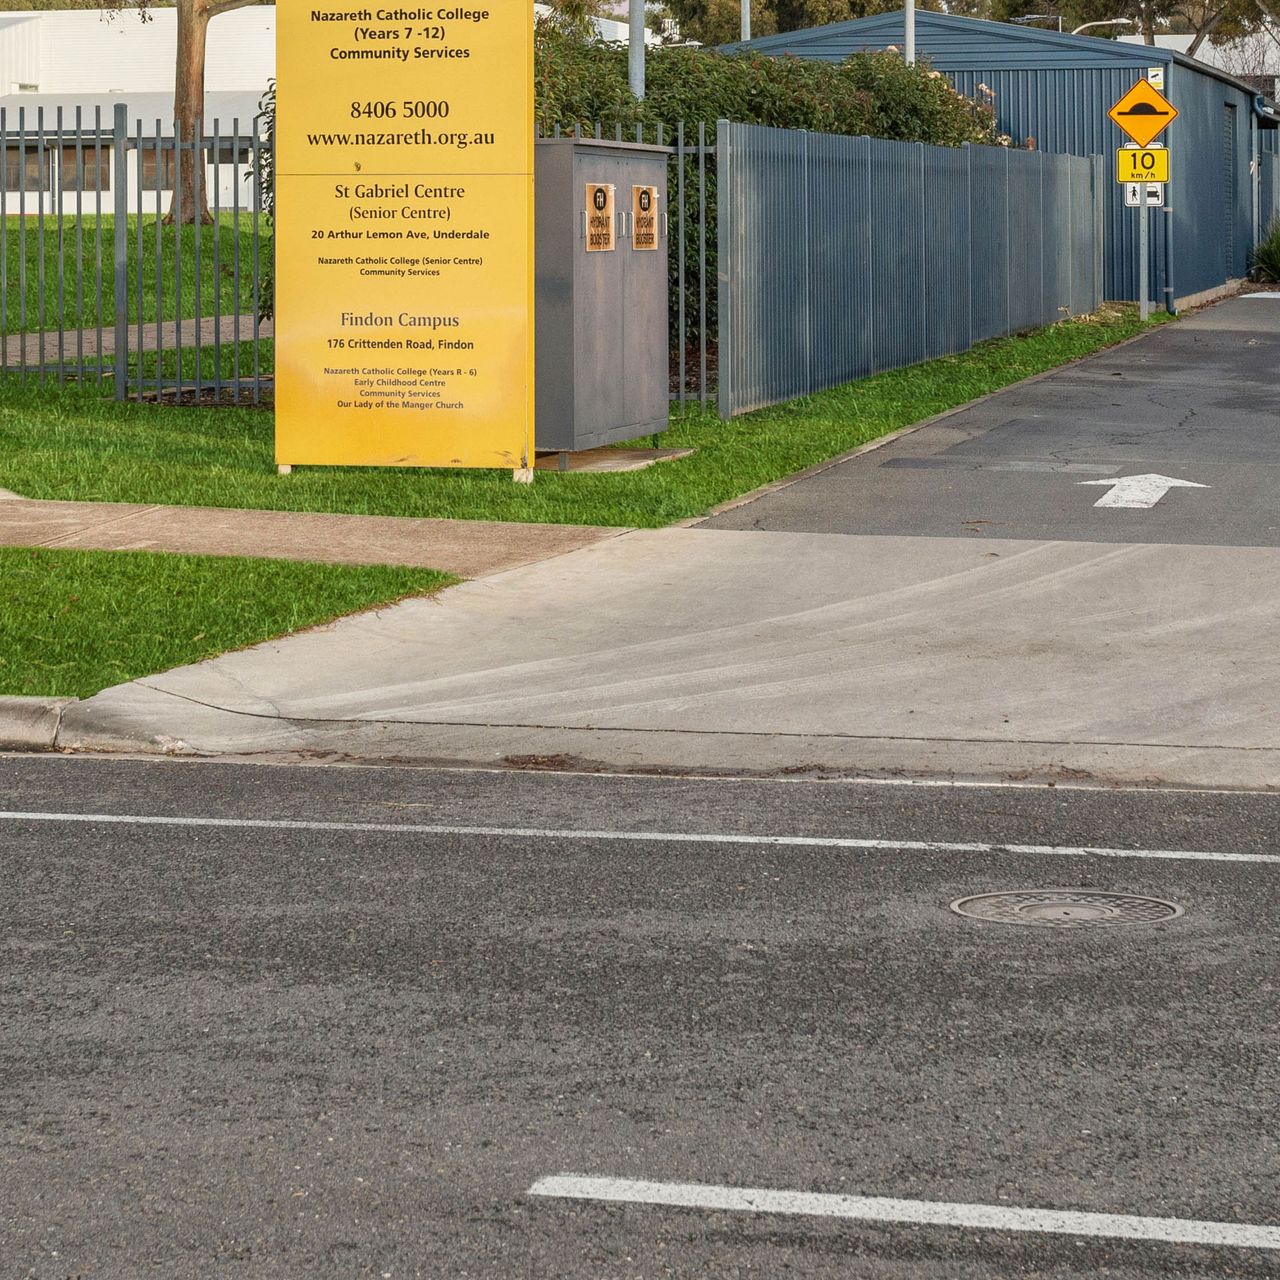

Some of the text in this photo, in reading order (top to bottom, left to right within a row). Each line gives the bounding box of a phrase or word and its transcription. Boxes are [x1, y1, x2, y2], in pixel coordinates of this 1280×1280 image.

[311, 8, 489, 22] Nazareth Catholic College
[355, 26, 445, 41] (Years 7 -12)
[331, 46, 469, 62] Community Services
[351, 101, 449, 118] 8406 5000
[307, 129, 494, 149] www.nazareth.org.au
[1130, 152, 1155, 170] 10
[335, 184, 465, 198] St Gabriel Centre
[596, 192, 604, 207] FH
[641, 194, 648, 208] FH
[350, 206, 450, 221] (Senior Centre)
[312, 230, 489, 239] 20 Arthur Lemon Ave, Underdale
[590, 233, 610, 246] BOOSTER
[390, 257, 420, 266] College
[422, 257, 451, 265] (Senior
[453, 257, 482, 265] Centre)
[360, 268, 440, 277] Community Services
[342, 312, 459, 330] Findon Campus
[328, 339, 473, 350] 176 Crittenden Road, Findon
[397, 368, 427, 377] College
[430, 368, 454, 376] (Years
[355, 378, 374, 388] Early
[360, 390, 405, 399] Community
[354, 400, 373, 409] Lady
[402, 401, 433, 410] Manger
